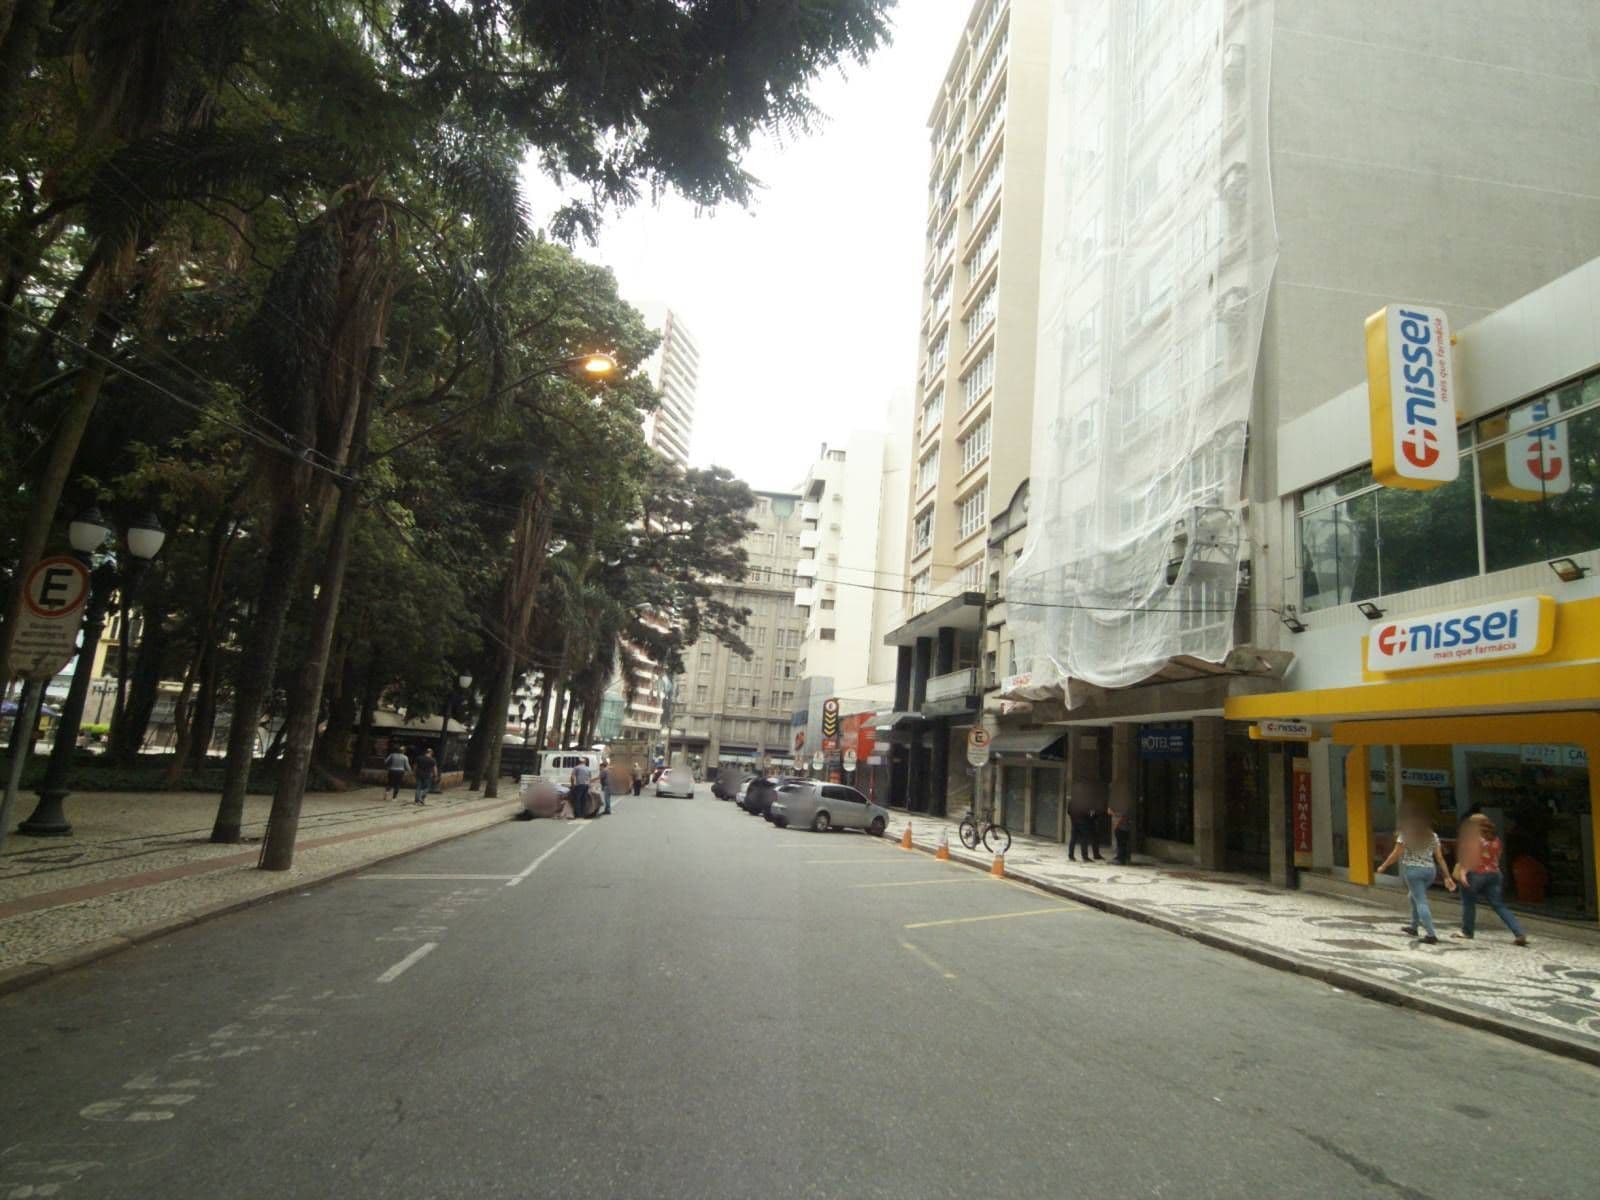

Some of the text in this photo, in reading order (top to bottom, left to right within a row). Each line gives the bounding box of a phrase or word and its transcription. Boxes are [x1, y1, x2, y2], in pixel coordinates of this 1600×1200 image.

[1399, 308, 1438, 426] nissei
[1438, 360, 1448, 379] que
[1439, 381, 1449, 402] mais
[39, 569, 74, 606] E
[1409, 608, 1519, 652] nissei
[1433, 650, 1454, 660] mais
[1455, 648, 1473, 659] que
[975, 731, 984, 743] E
[1141, 735, 1169, 749] HOTEL
